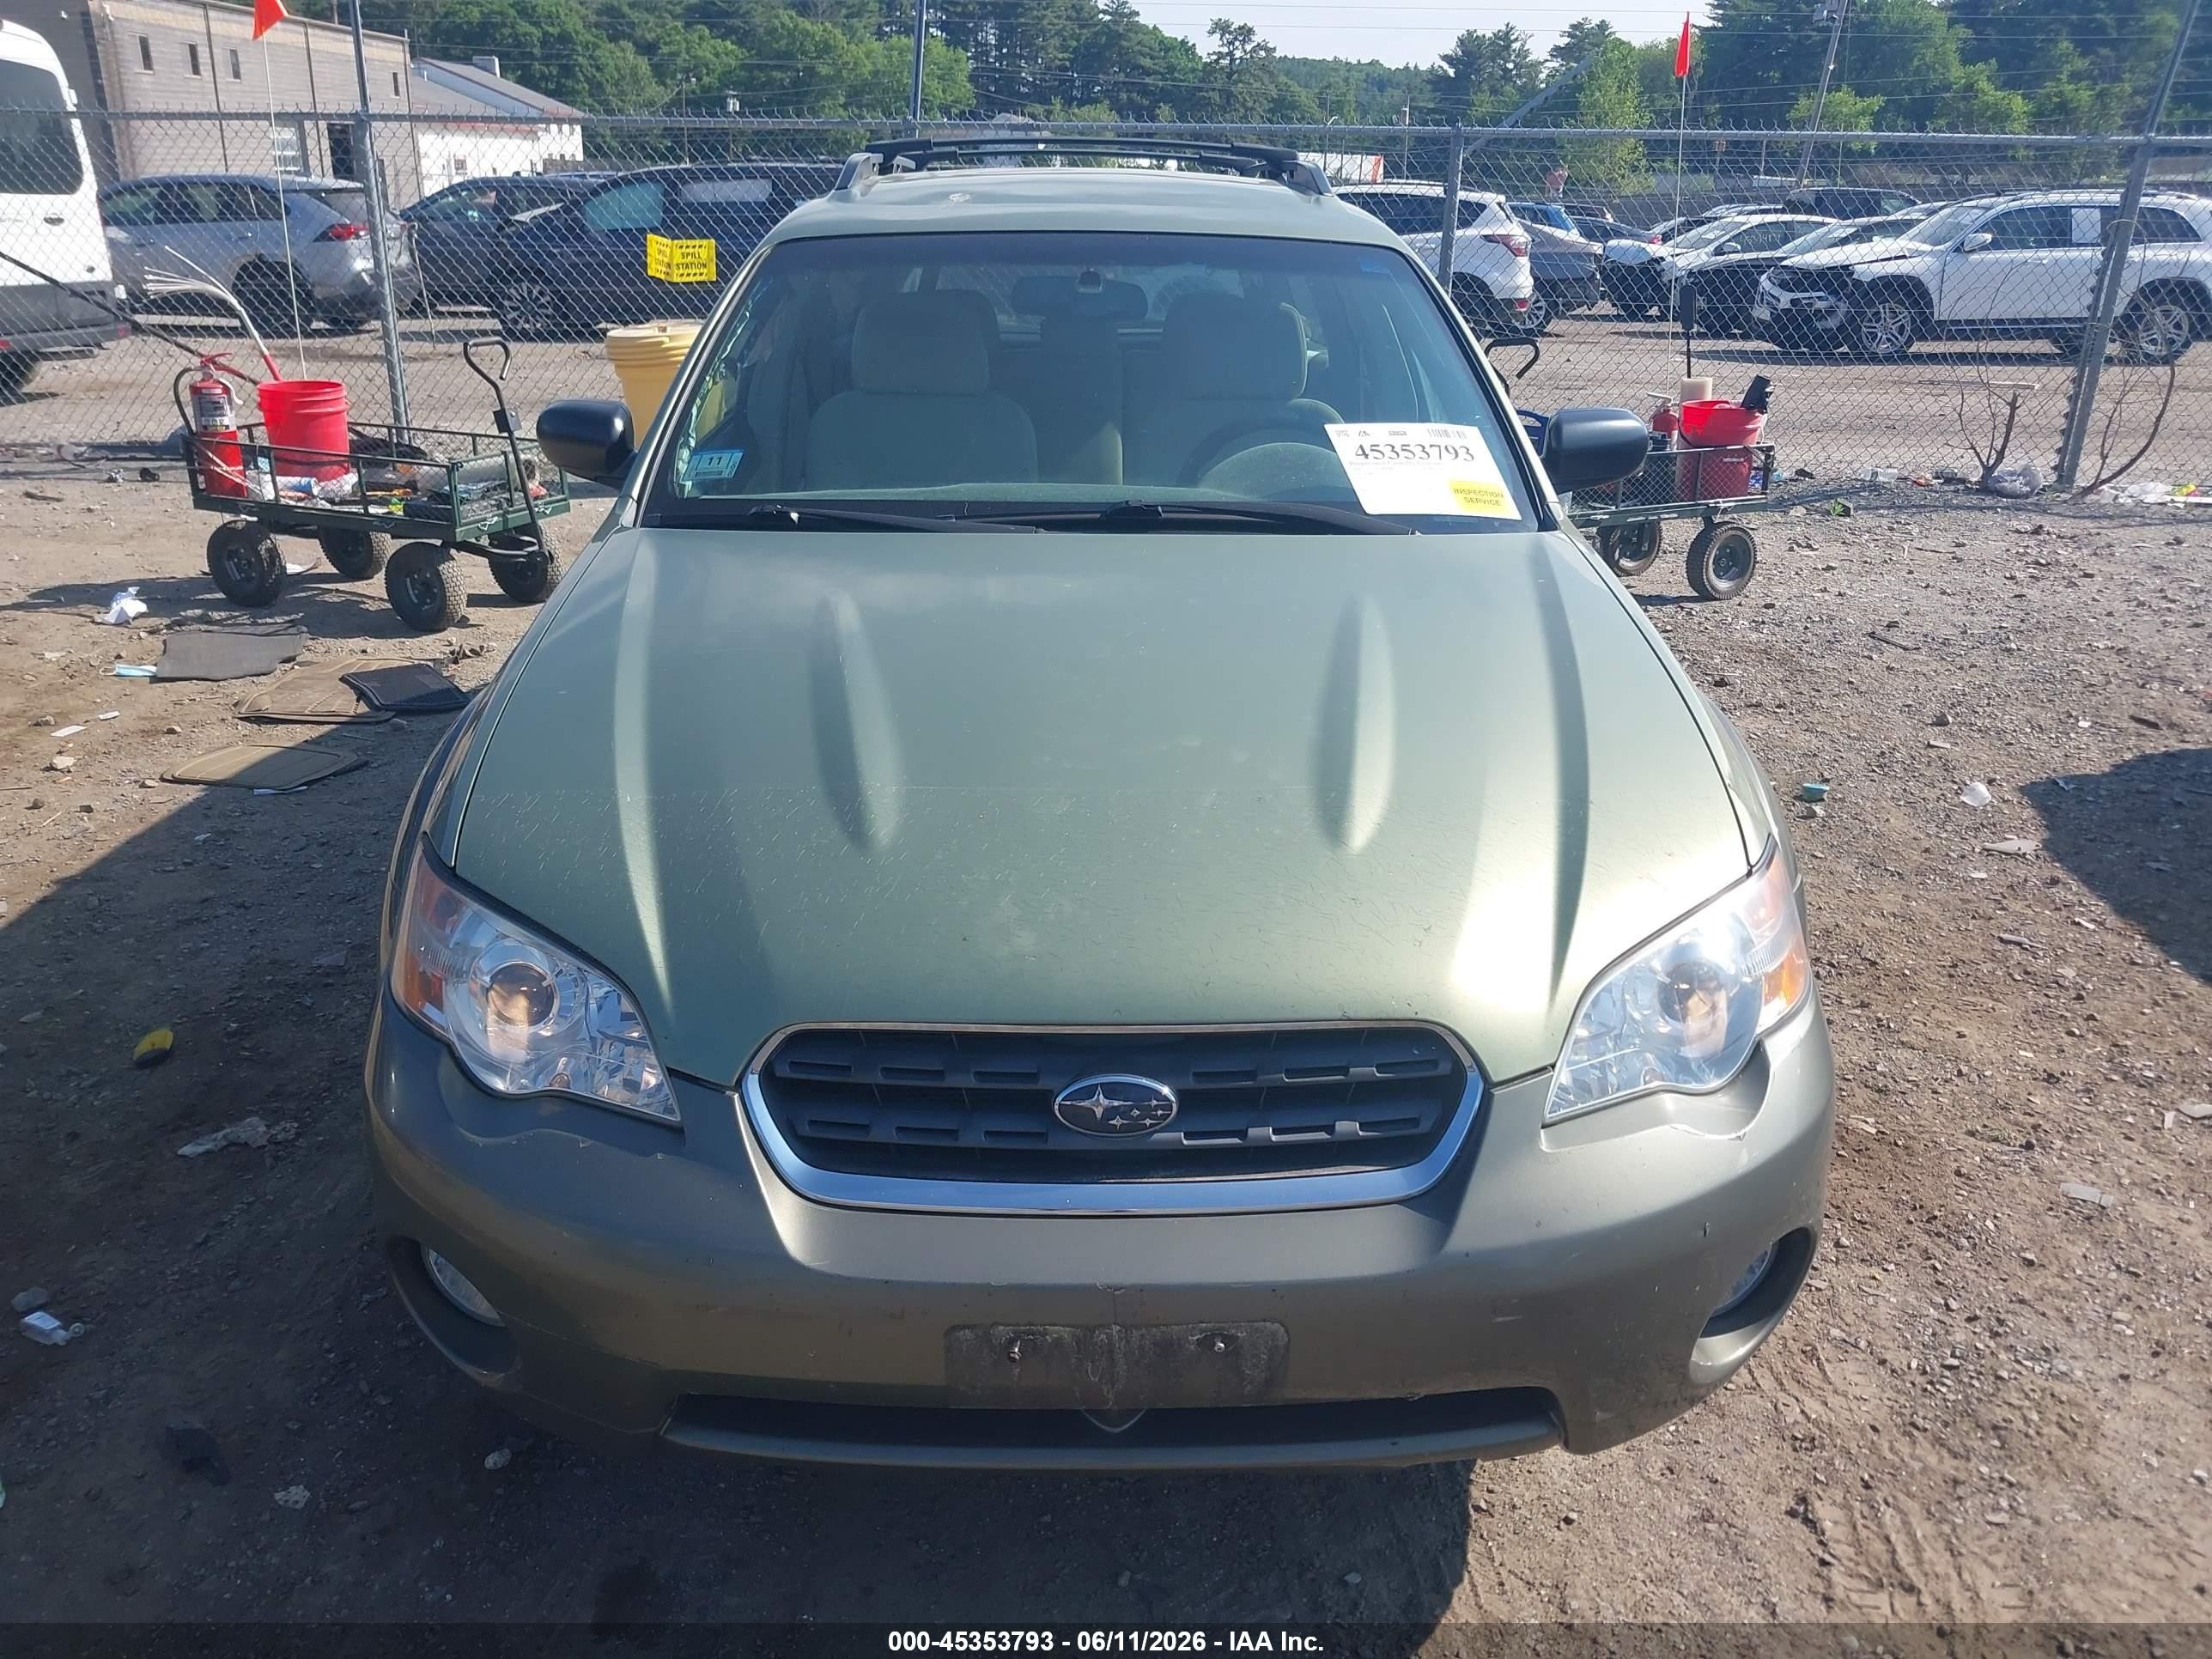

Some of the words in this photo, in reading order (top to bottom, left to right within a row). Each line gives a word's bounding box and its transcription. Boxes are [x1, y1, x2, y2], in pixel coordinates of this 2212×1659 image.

[680, 251, 702, 260] SPILL
[675, 262, 707, 270] STATION
[1355, 443, 1475, 462] 45353793
[708, 456, 723, 466] 11
[1453, 488, 1504, 498] INSPECTION
[1463, 497, 1503, 506] SERVICE
